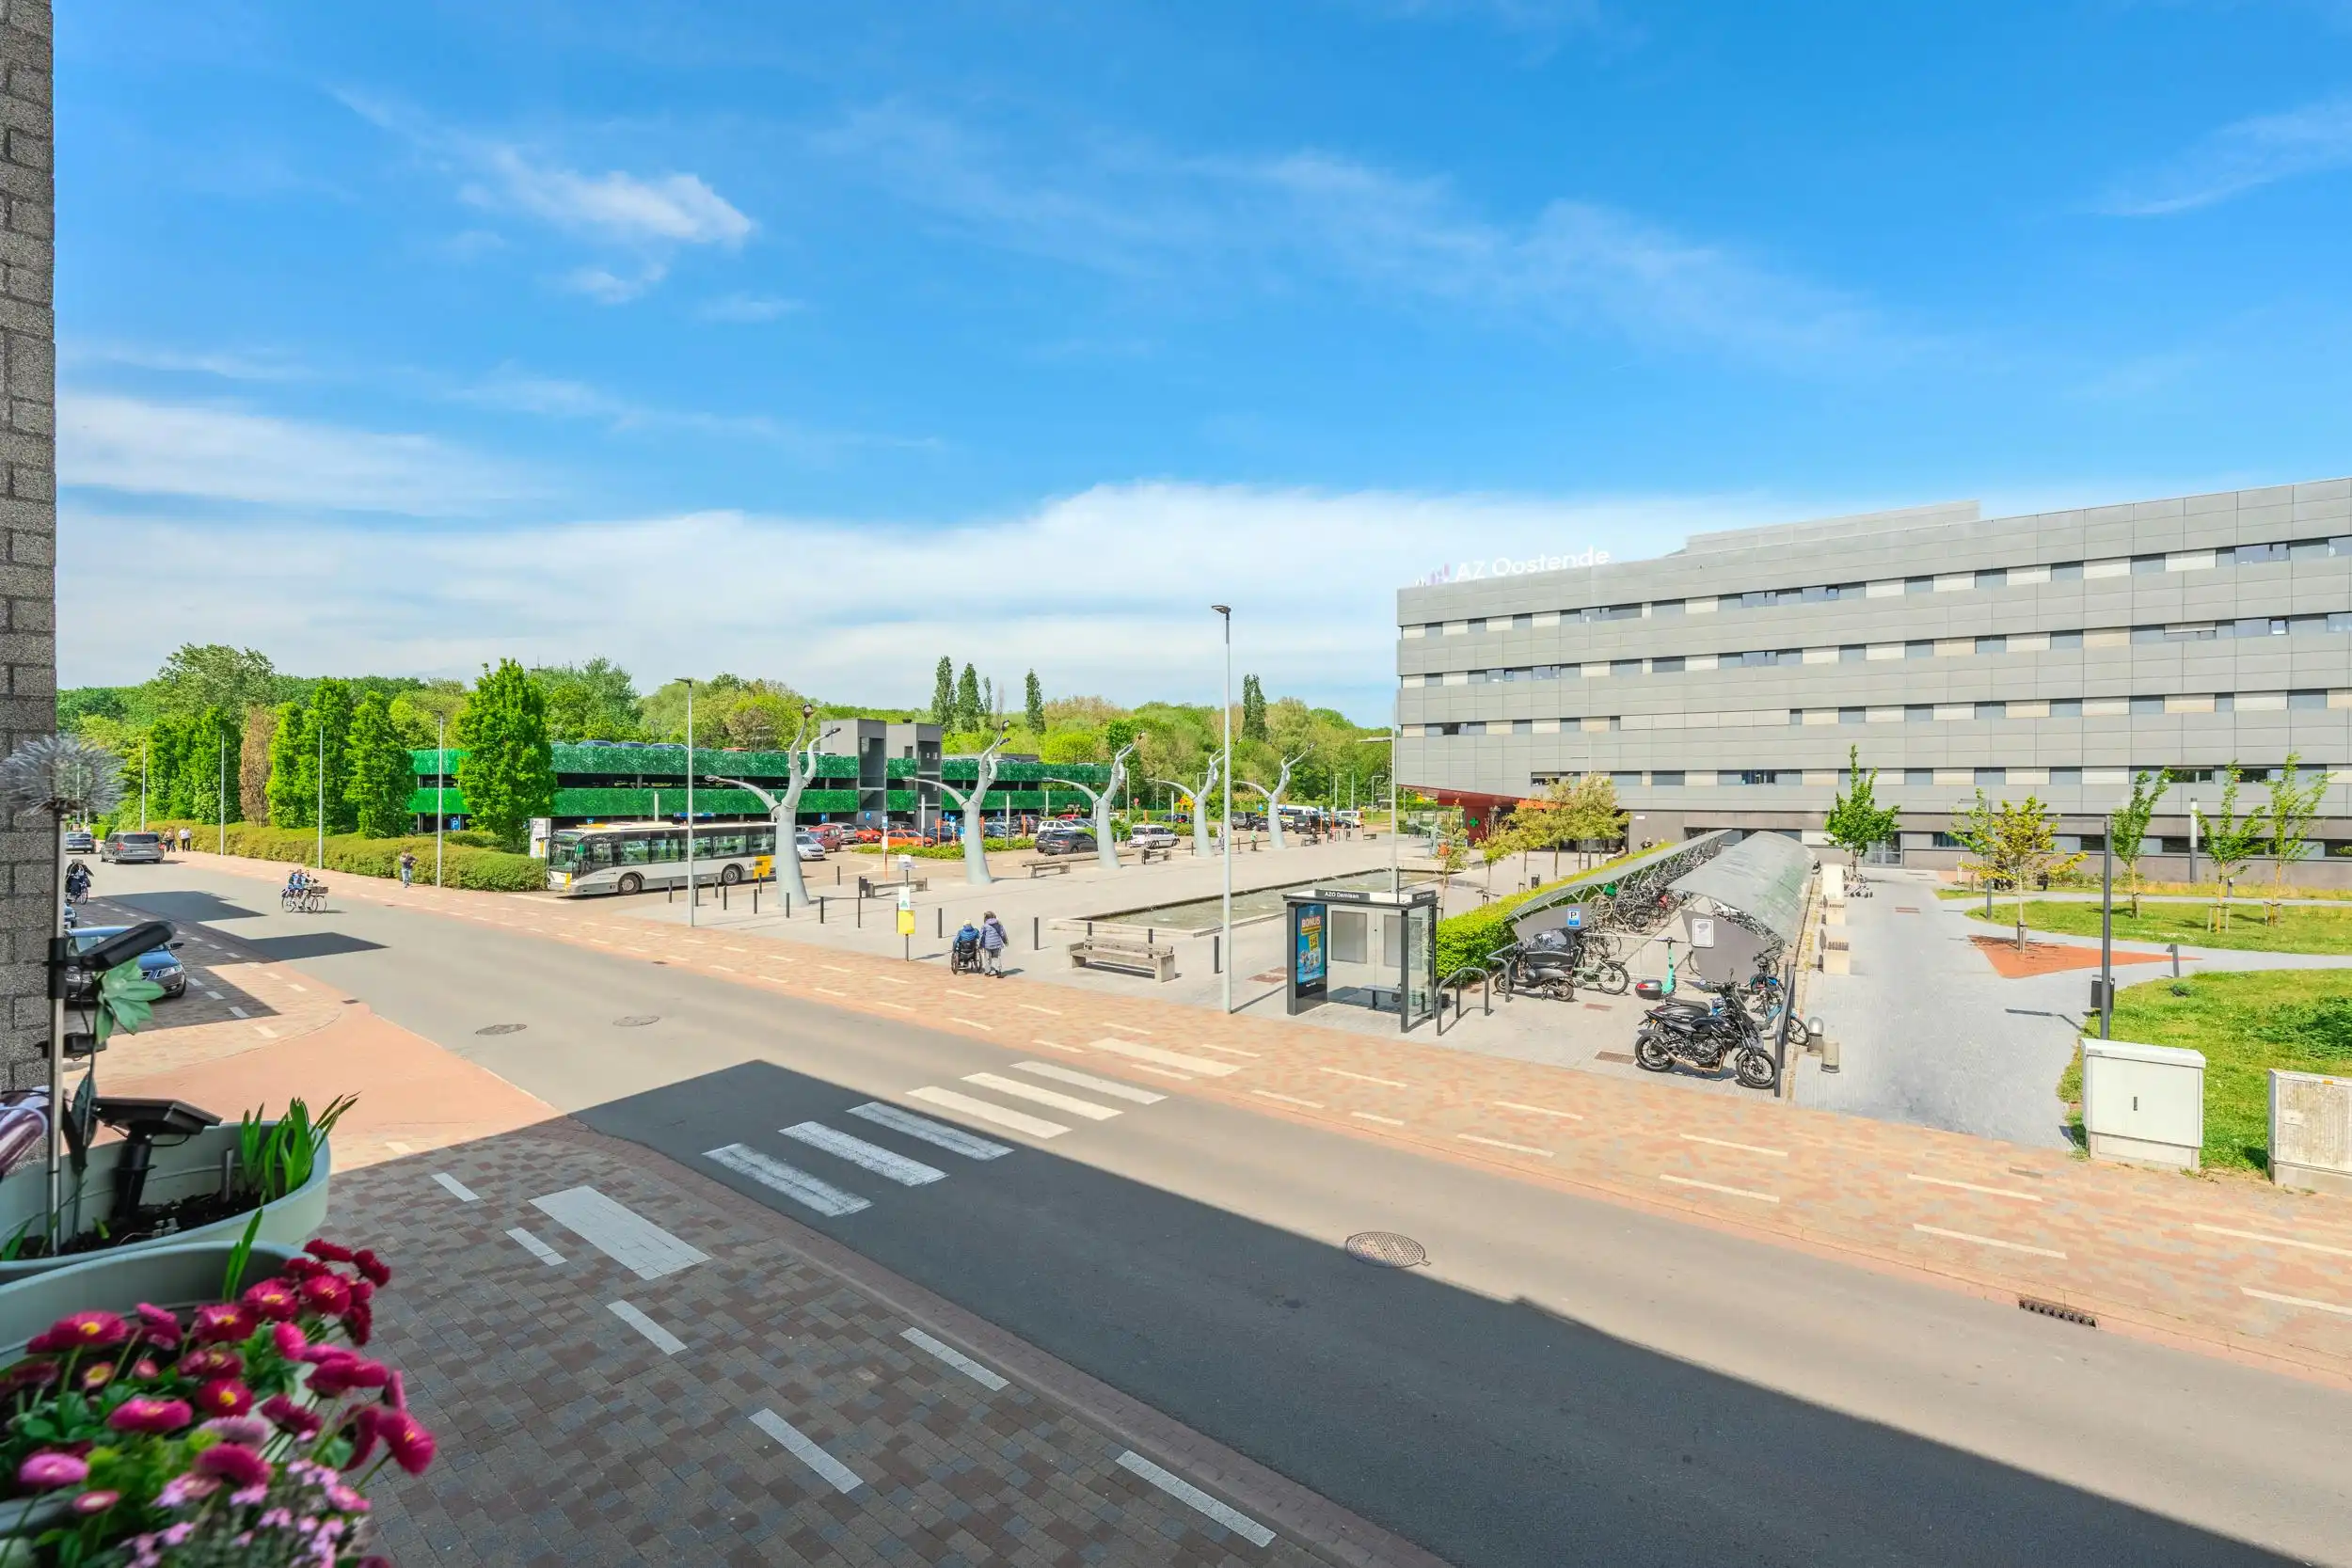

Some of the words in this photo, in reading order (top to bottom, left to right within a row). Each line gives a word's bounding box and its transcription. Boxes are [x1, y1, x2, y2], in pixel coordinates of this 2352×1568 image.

[1455, 560, 1486, 582] AZ
[1491, 545, 1611, 577] Oostende
[1301, 916, 1321, 927] BONUS
